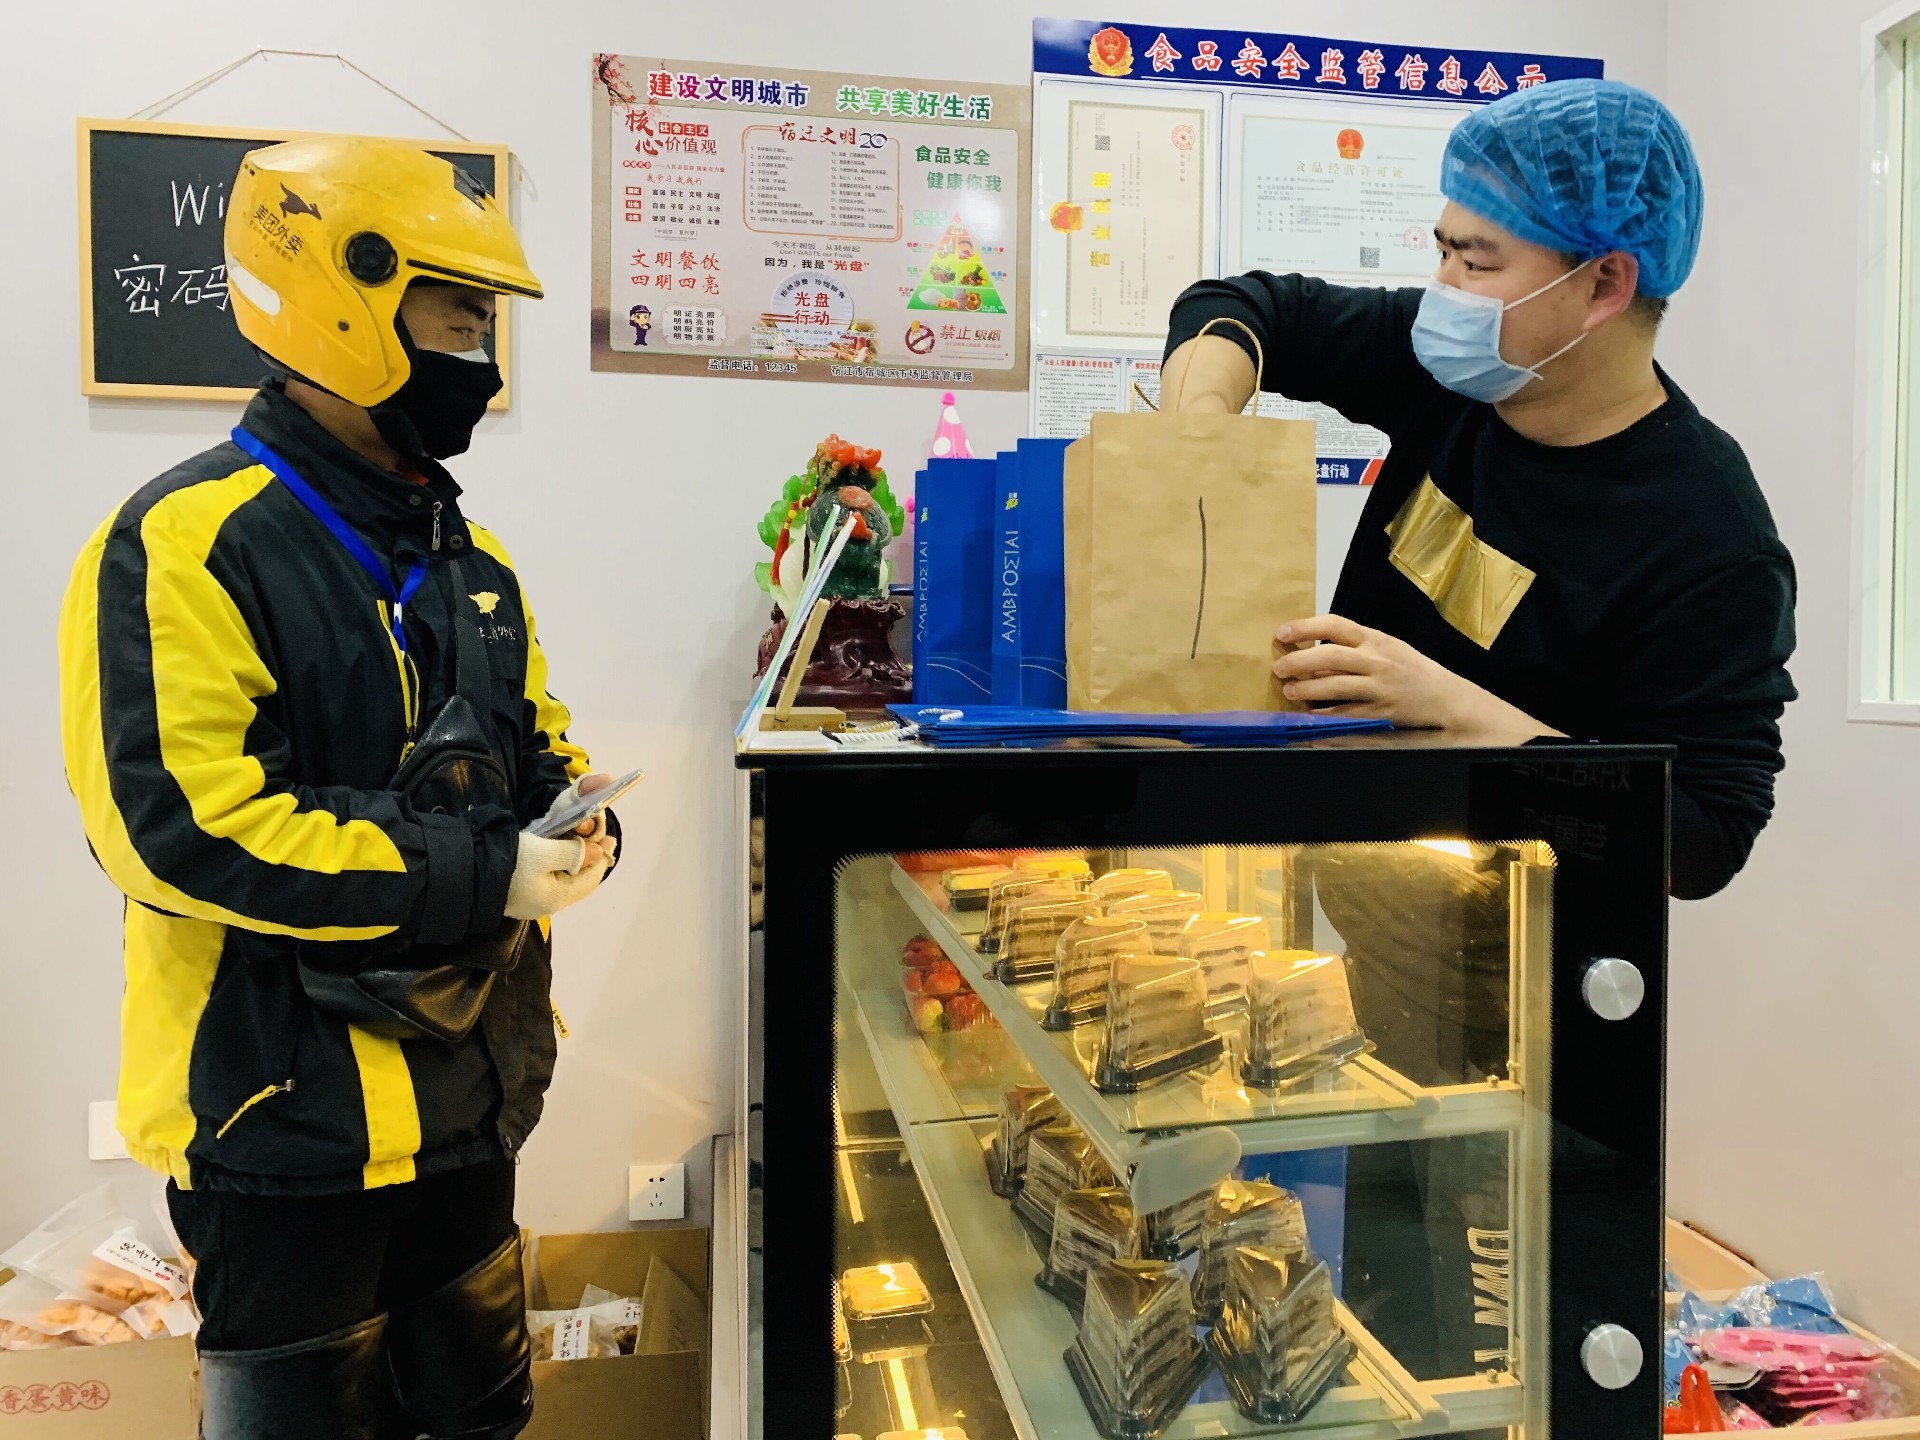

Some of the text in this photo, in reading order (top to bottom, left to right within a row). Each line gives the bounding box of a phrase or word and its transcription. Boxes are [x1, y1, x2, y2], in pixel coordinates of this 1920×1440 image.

[1144, 32, 1547, 97] 食品安全监管信息公示
[648, 71, 993, 120] 建设文明城市 共享美好生活
[658, 121, 709, 137] 社会主义
[915, 144, 990, 166] 食品安全
[1295, 160, 1405, 178] 食品经营许可证
[926, 171, 1002, 192] 健康你我
[253, 203, 304, 256] 美团外卖
[630, 249, 721, 271] 文明餐饮
[113, 253, 228, 317] 密码
[631, 274, 720, 295] 四明四亮
[794, 291, 830, 308] 光盘
[794, 310, 830, 326] 行动
[764, 361, 798, 373] 12345
